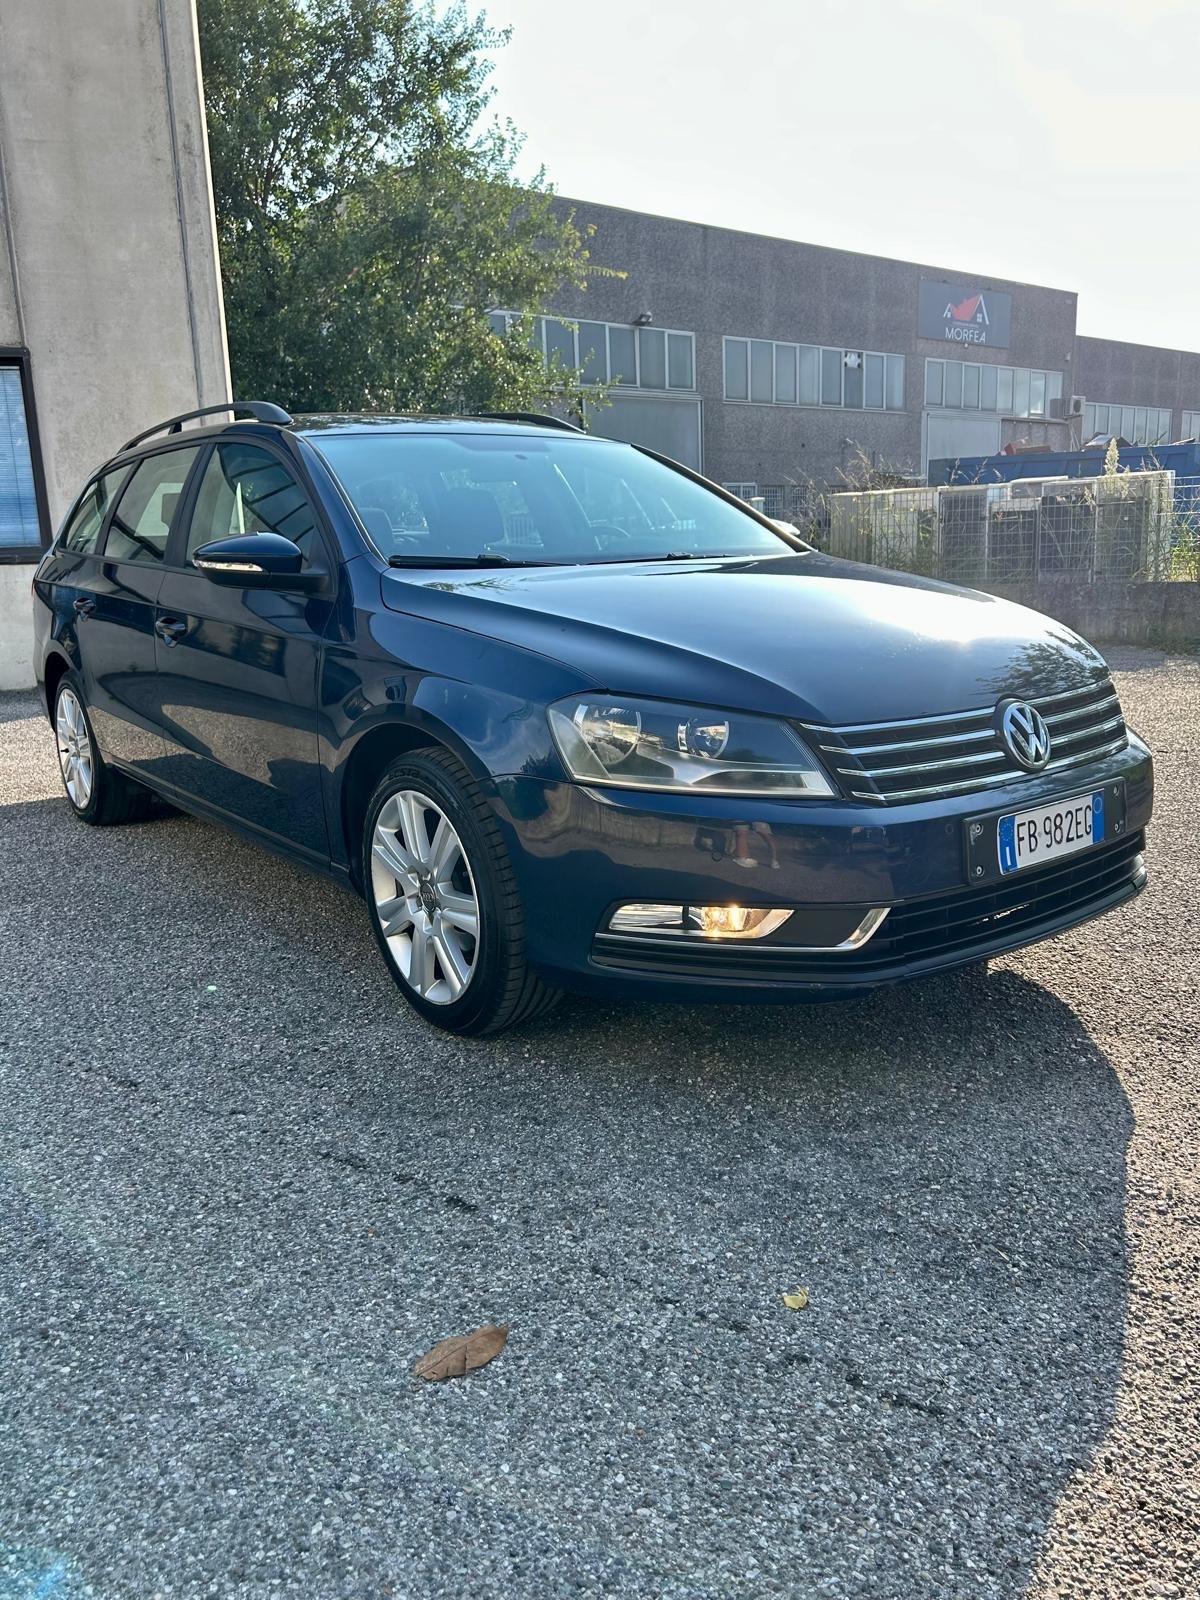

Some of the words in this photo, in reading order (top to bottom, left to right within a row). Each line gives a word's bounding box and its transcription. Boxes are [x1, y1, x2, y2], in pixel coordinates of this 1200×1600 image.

[945, 327, 986, 343] MORFEA
[1016, 819, 1038, 857] FB
[1043, 804, 1092, 849] 982EG
